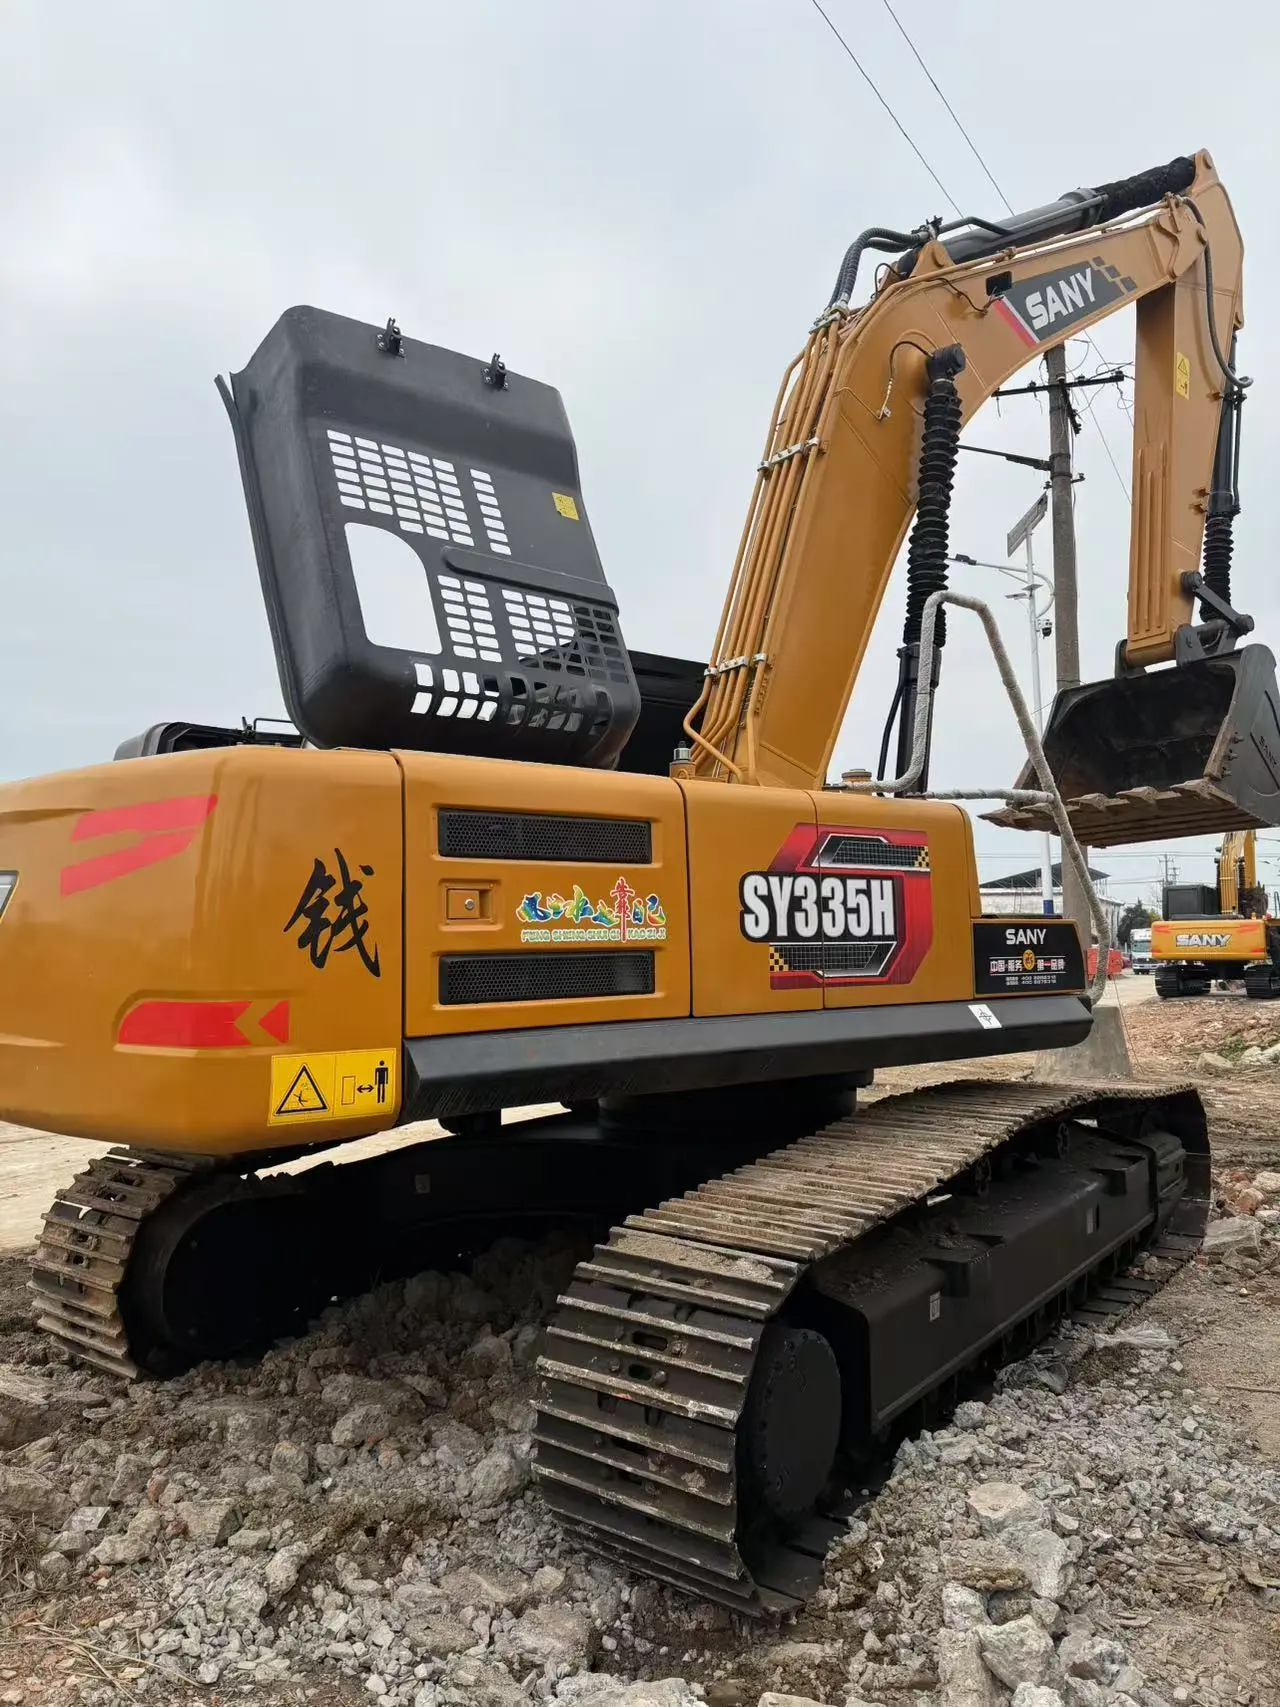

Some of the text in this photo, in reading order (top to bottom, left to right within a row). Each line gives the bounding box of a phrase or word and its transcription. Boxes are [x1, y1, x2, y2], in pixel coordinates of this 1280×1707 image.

[1025, 267, 1096, 330] SANY
[283, 847, 381, 978] 钱
[743, 875, 895, 938] SY335H
[1005, 928, 1047, 945] SANY
[1175, 933, 1233, 947] SANY
